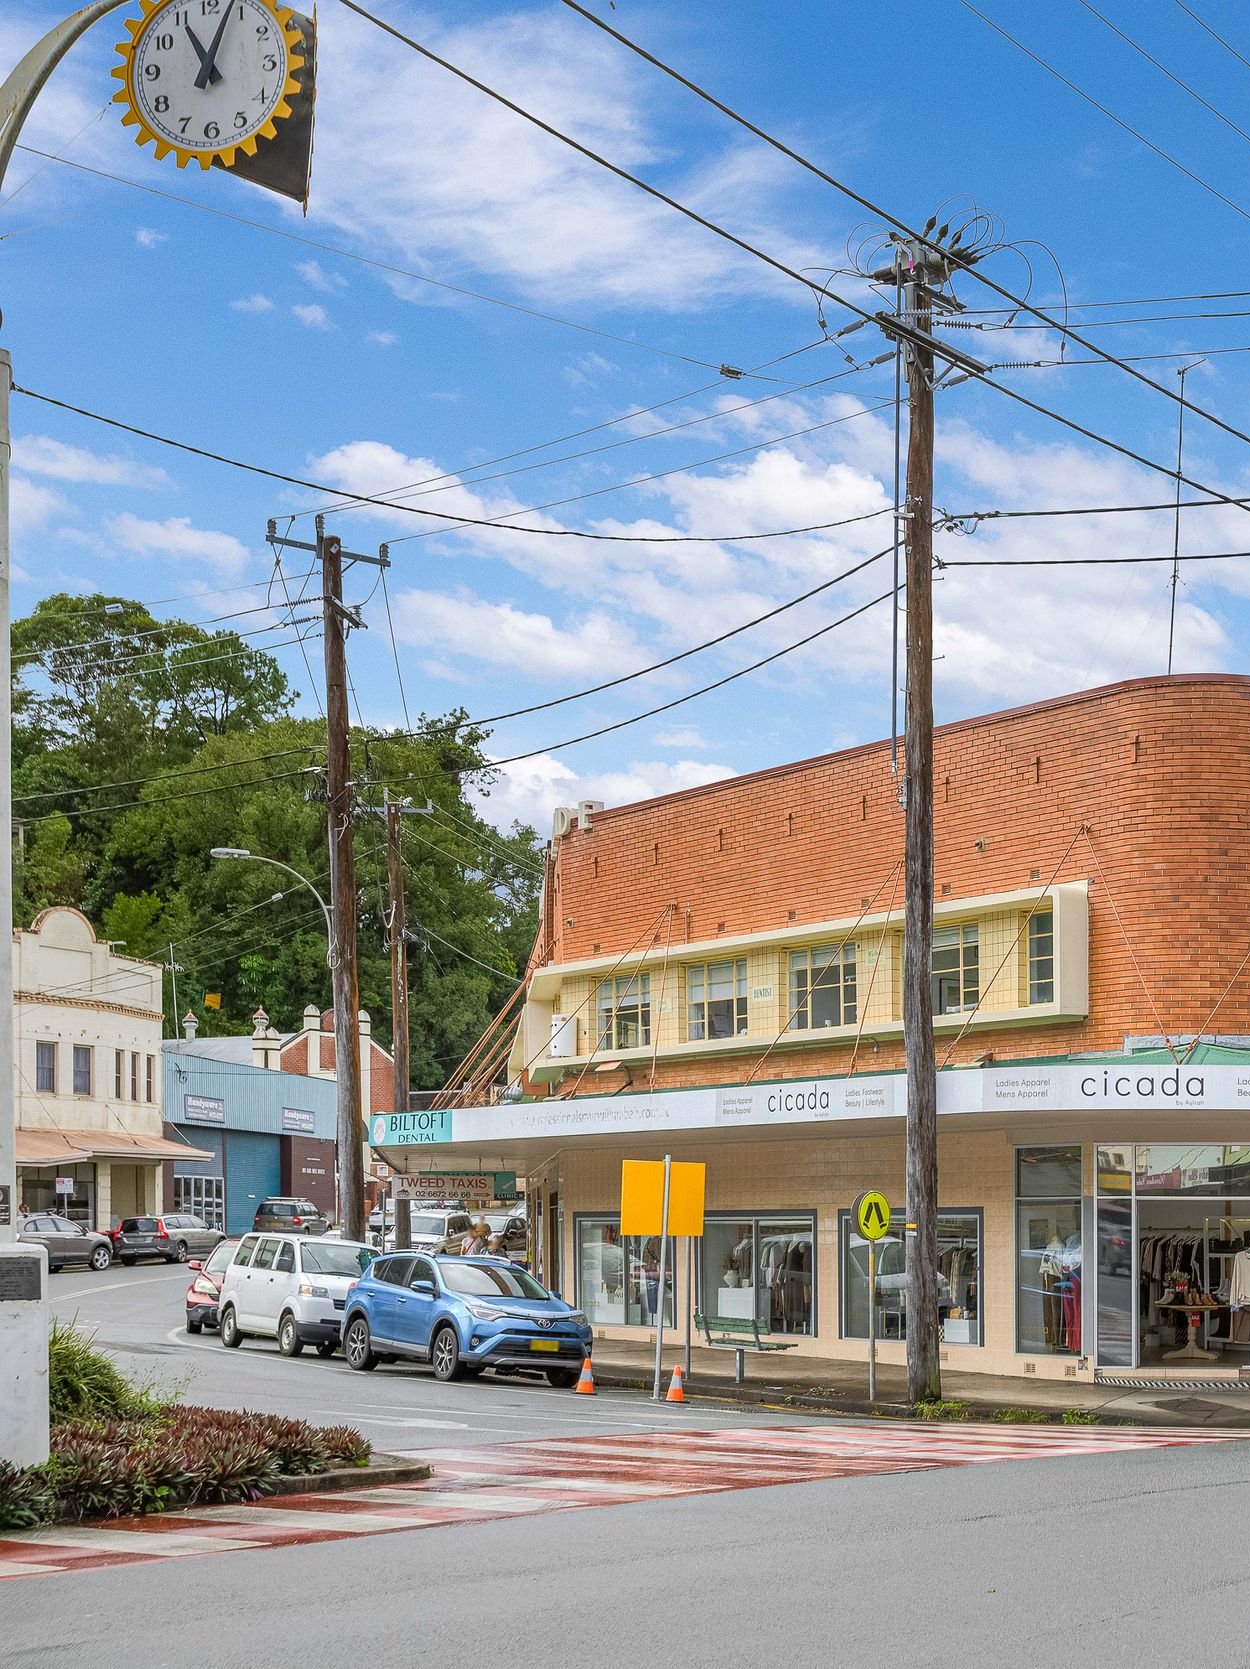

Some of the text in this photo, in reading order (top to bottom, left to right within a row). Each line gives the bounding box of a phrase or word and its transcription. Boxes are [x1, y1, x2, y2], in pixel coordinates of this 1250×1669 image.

[201, 0, 220, 15] 12
[237, 5, 244, 21] 1
[174, 11, 189, 26] 11
[154, 33, 174, 50] 10
[256, 26, 270, 41] 2
[263, 54, 277, 71] 3
[145, 64, 161, 81] 9
[252, 87, 269, 104] 4
[154, 95, 169, 113] 8
[178, 117, 192, 134] 7
[233, 112, 248, 128] 5
[204, 122, 220, 139] 6
[1021, 1078, 1050, 1087] Apparel
[1081, 1068, 1204, 1096] cicada
[768, 1084, 829, 1112] cicada
[846, 1087, 883, 1097] Ladies Footwear
[1017, 1089, 1048, 1098] Apparel
[846, 1098, 884, 1108] Beauty Lifestyle
[390, 1112, 447, 1131] BILTOFT
[398, 1133, 436, 1143] DENTAL
[399, 1178, 487, 1189] TWEED TAXIS
